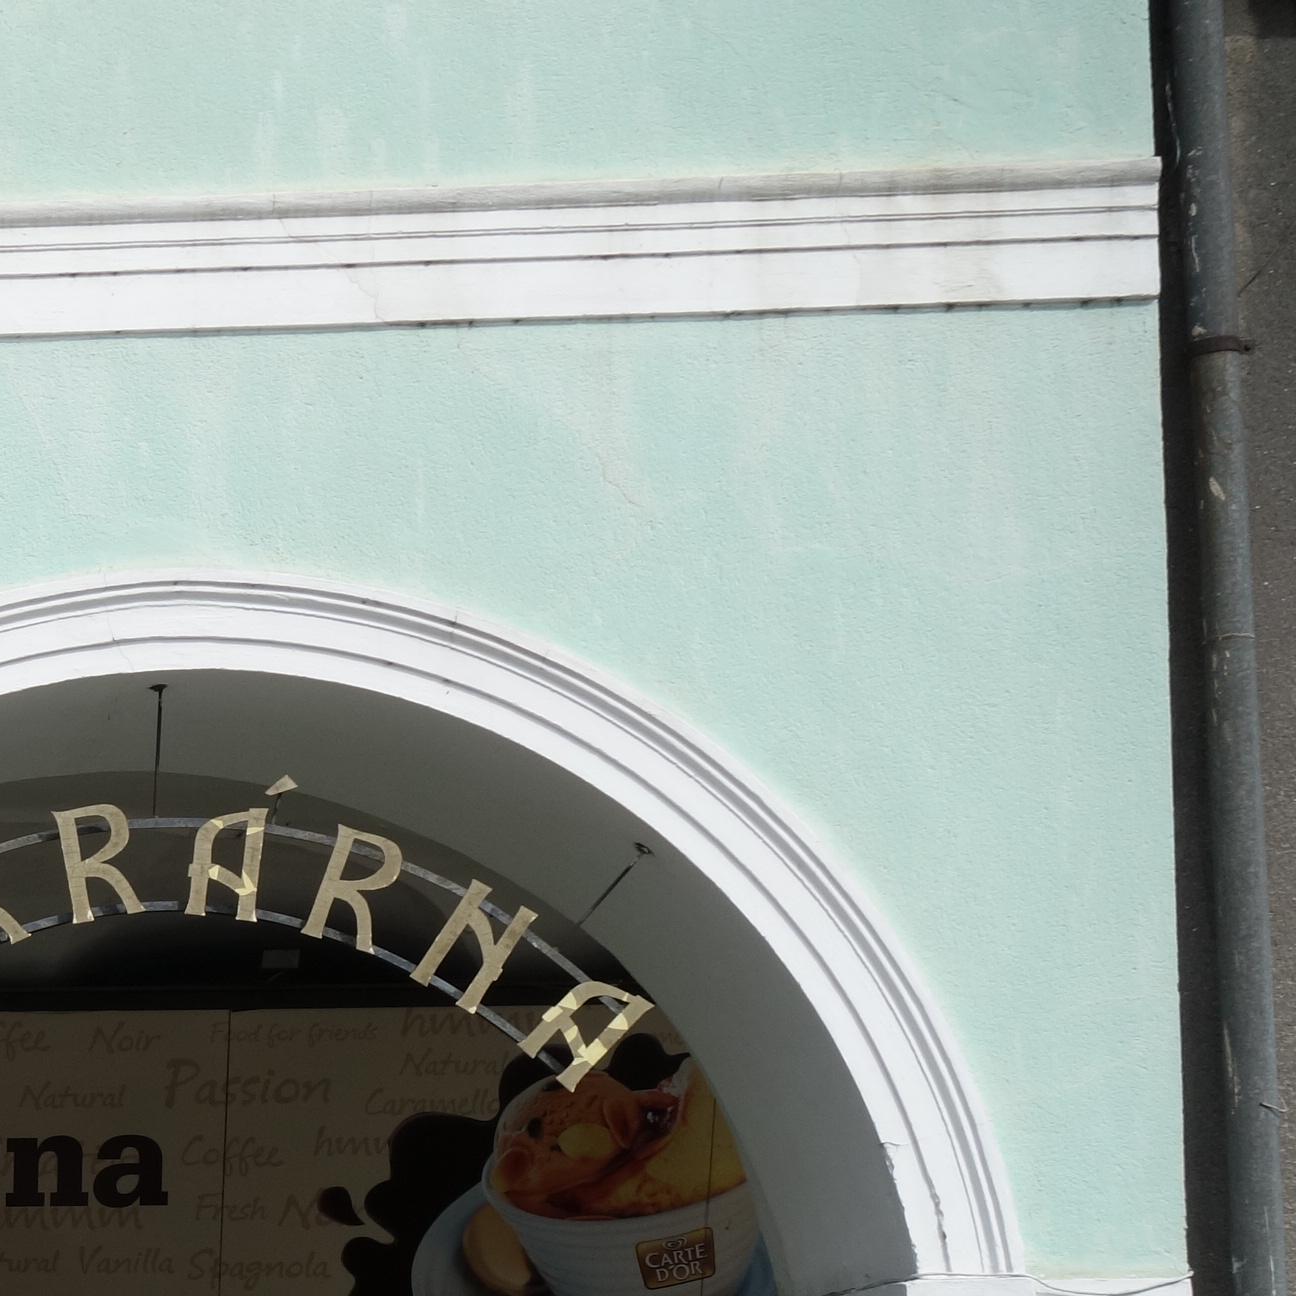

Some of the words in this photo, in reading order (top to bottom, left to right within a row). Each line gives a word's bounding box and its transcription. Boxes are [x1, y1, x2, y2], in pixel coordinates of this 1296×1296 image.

[88, 1021, 161, 1054] Noir
[18, 1081, 127, 1111] Natural
[163, 1058, 333, 1109] Passion
[78, 1246, 175, 1275] Vanilla
[187, 1249, 333, 1291] Spagnola
[644, 1243, 706, 1270] CARTE
